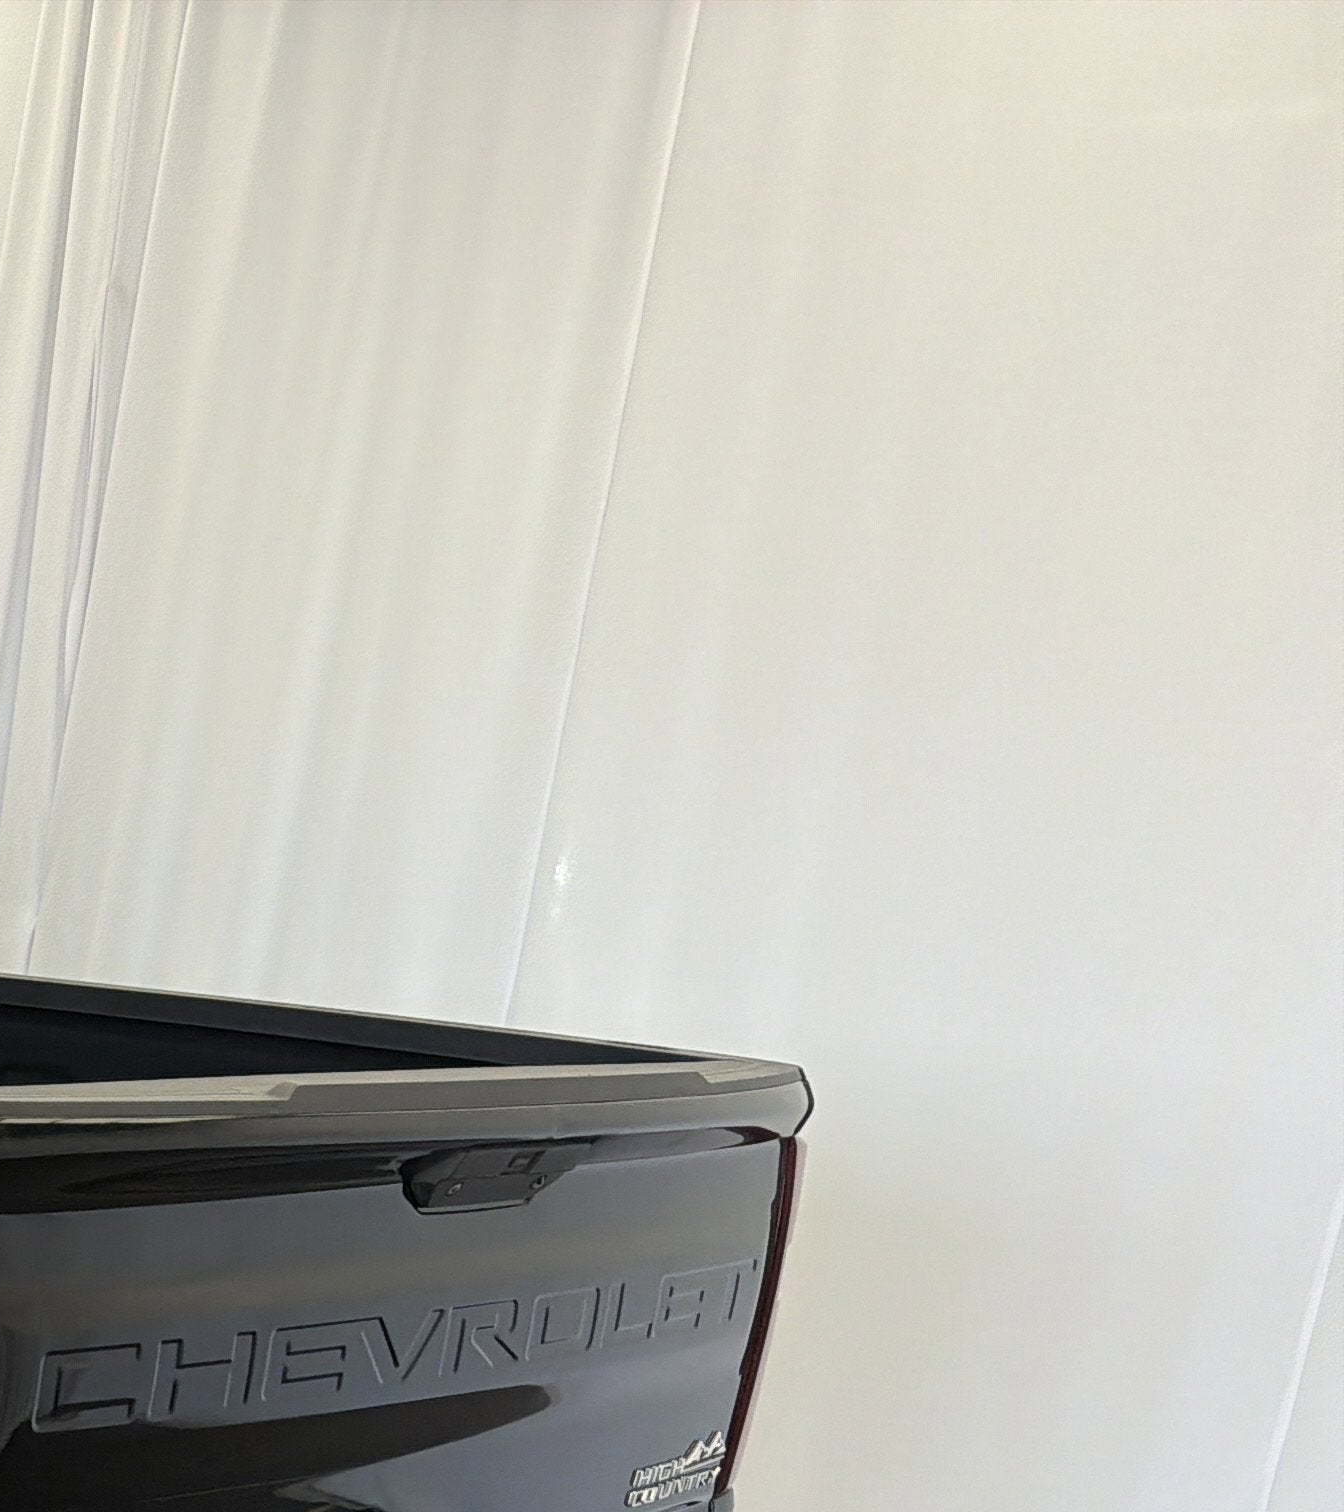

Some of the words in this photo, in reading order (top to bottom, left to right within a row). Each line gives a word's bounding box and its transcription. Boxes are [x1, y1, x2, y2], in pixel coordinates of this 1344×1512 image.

[32, 1259, 758, 1433] CHEVROLET
[624, 1465, 722, 1507] COUNTRY
[630, 1456, 687, 1488] HIGH
